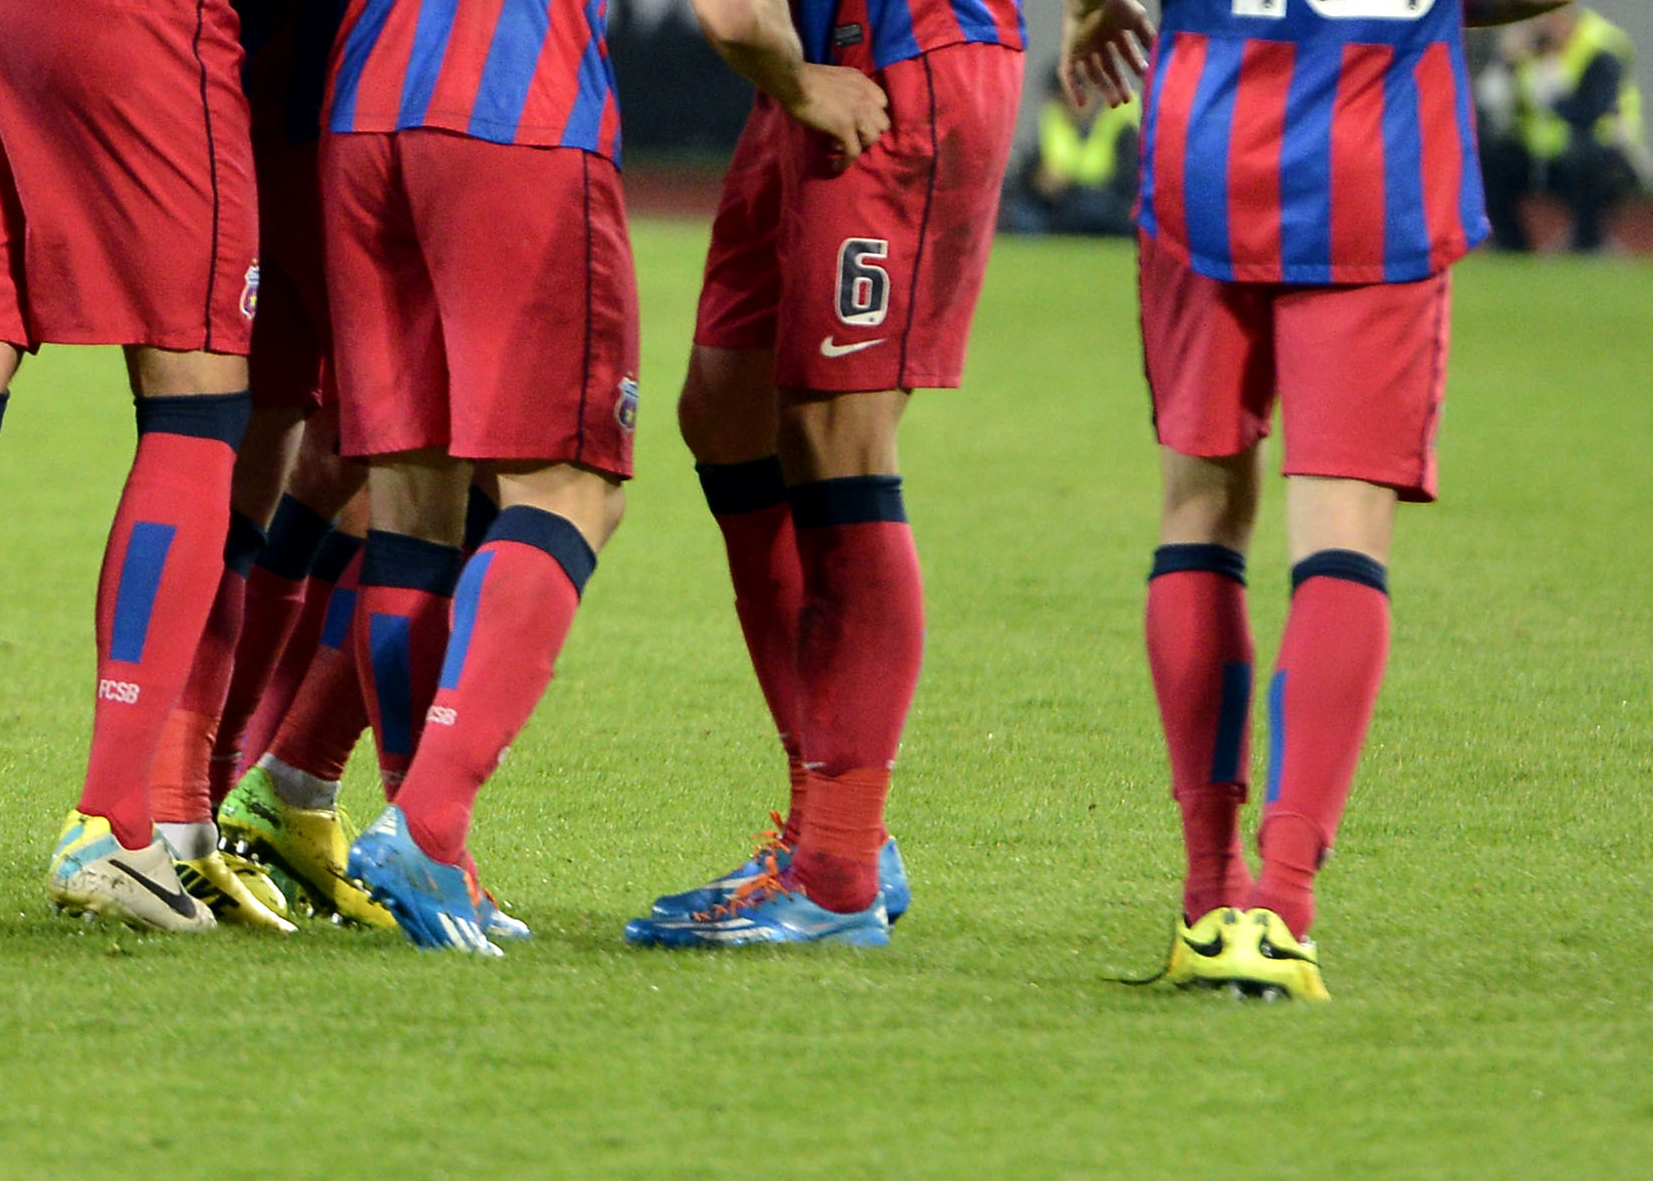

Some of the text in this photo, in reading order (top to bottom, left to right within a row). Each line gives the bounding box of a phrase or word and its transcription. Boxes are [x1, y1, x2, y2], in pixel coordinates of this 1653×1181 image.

[834, 237, 890, 327] 6
[98, 678, 141, 705] FCSB
[425, 705, 459, 727] CSB
